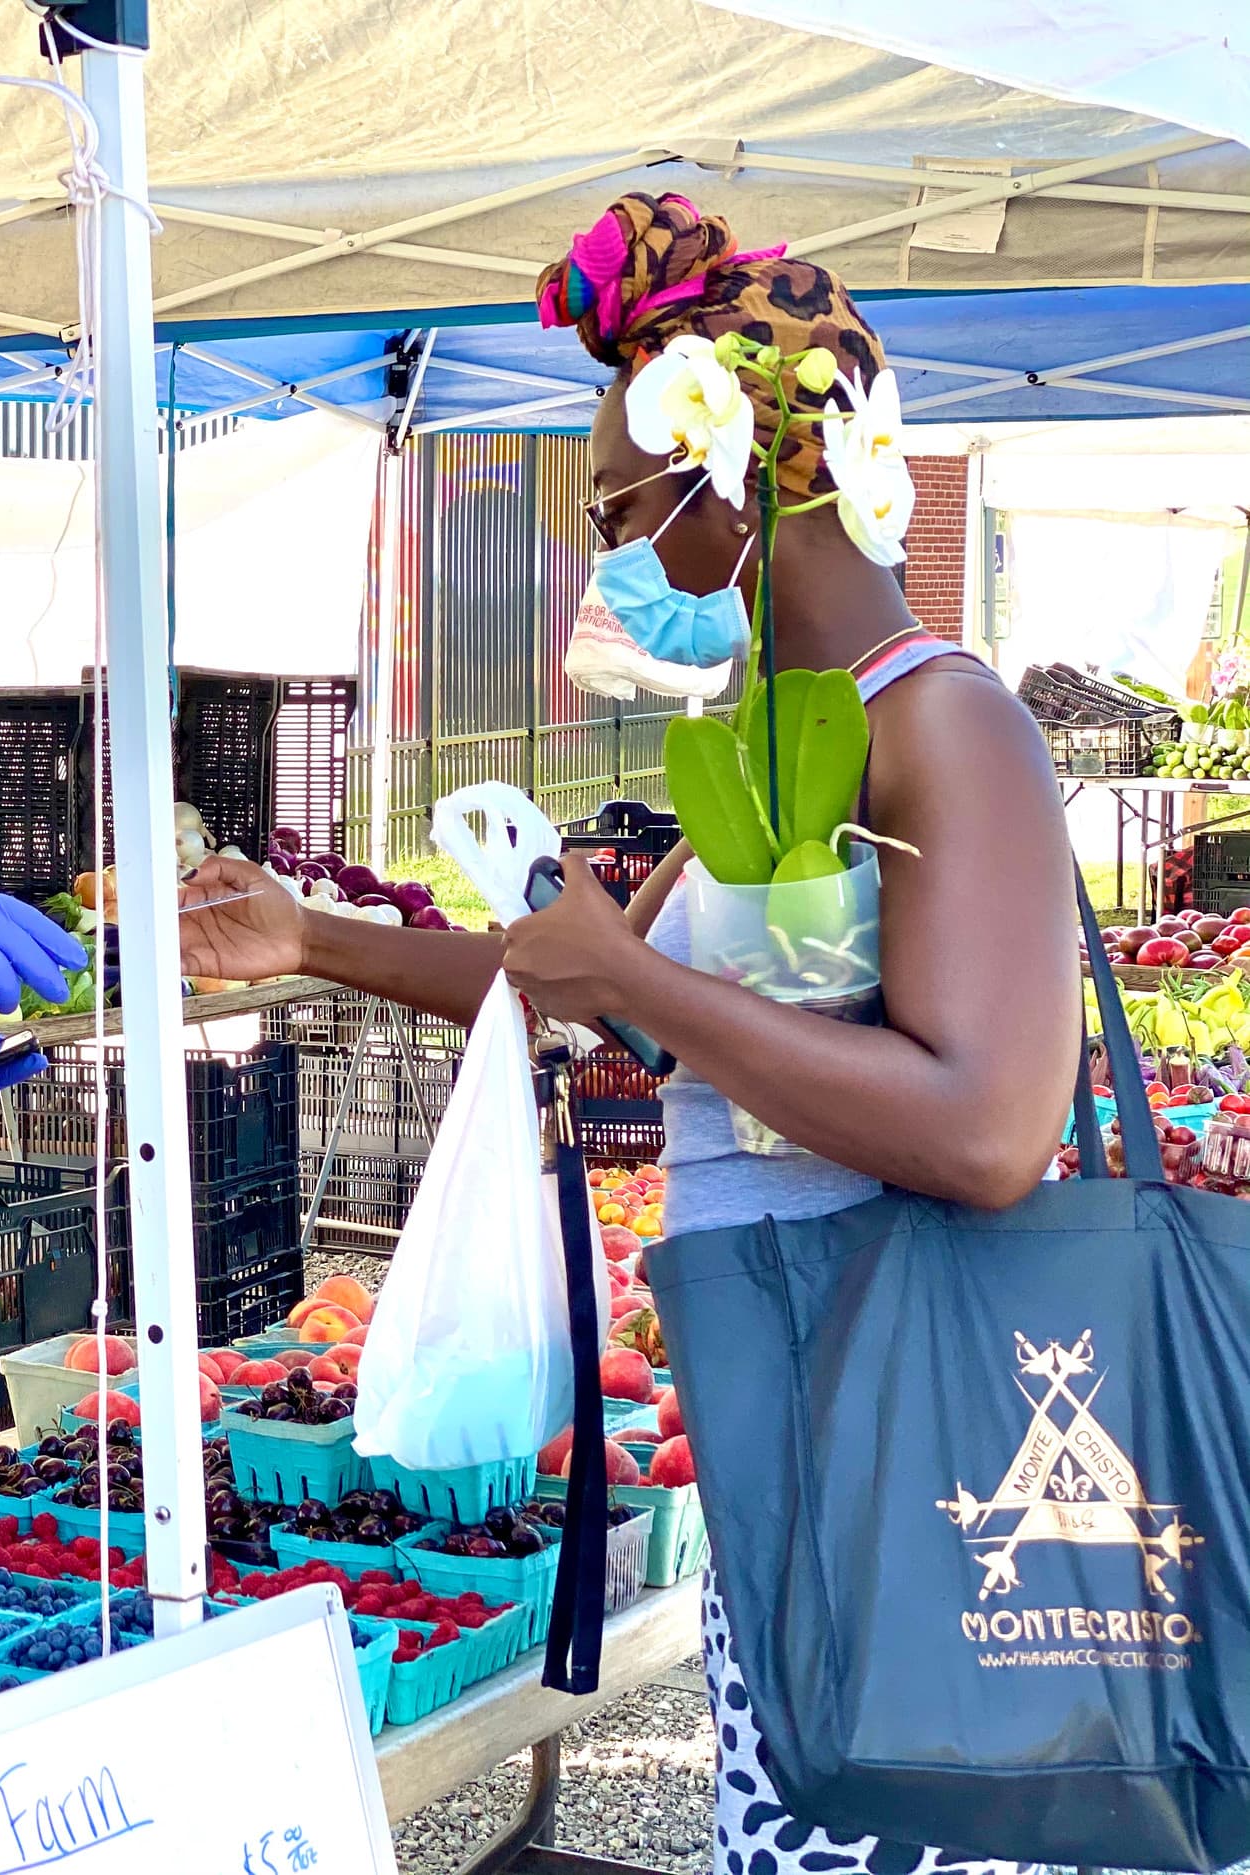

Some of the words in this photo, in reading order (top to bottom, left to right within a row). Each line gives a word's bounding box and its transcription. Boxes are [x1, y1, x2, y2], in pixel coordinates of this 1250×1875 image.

[1013, 1430, 1053, 1495] MONTE
[1074, 1430, 1131, 1496] CRISTO
[961, 1607, 1193, 1645] MONTECRISTO
